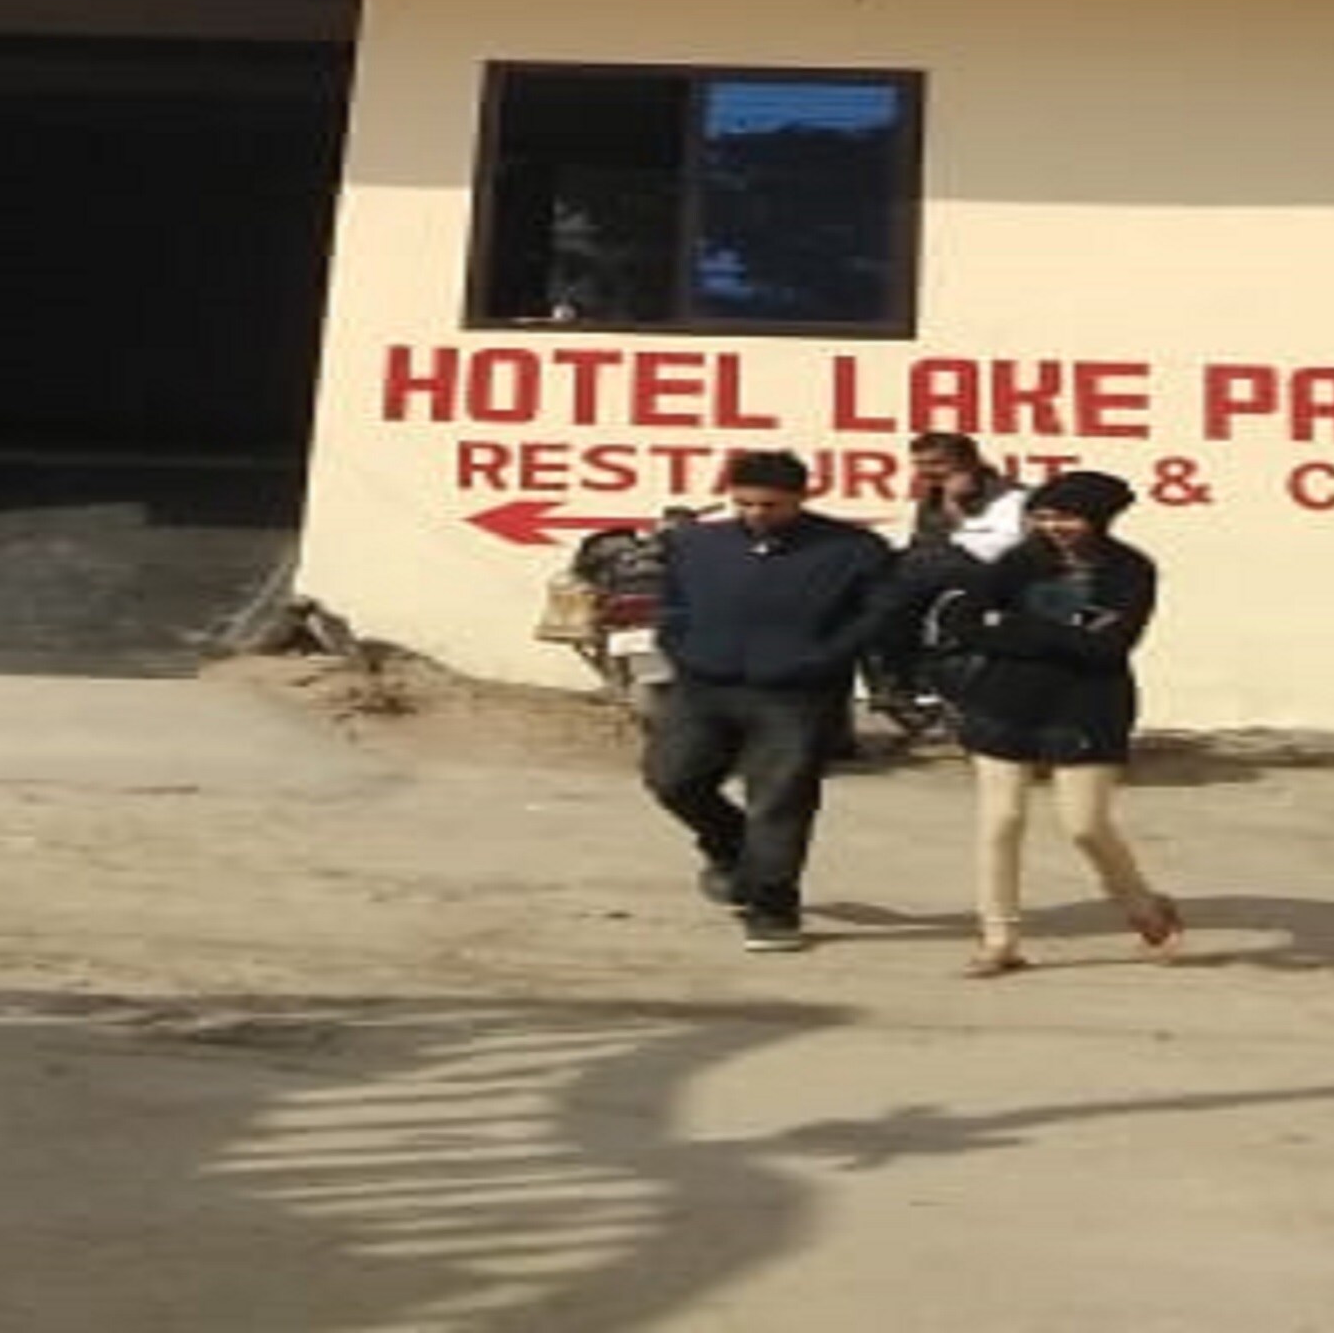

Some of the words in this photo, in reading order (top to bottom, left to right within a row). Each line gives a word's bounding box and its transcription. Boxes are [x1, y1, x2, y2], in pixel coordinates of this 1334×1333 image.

[382, 344, 779, 431] HOTEL
[832, 355, 1153, 439] LAKE
[1148, 456, 1212, 507] &
